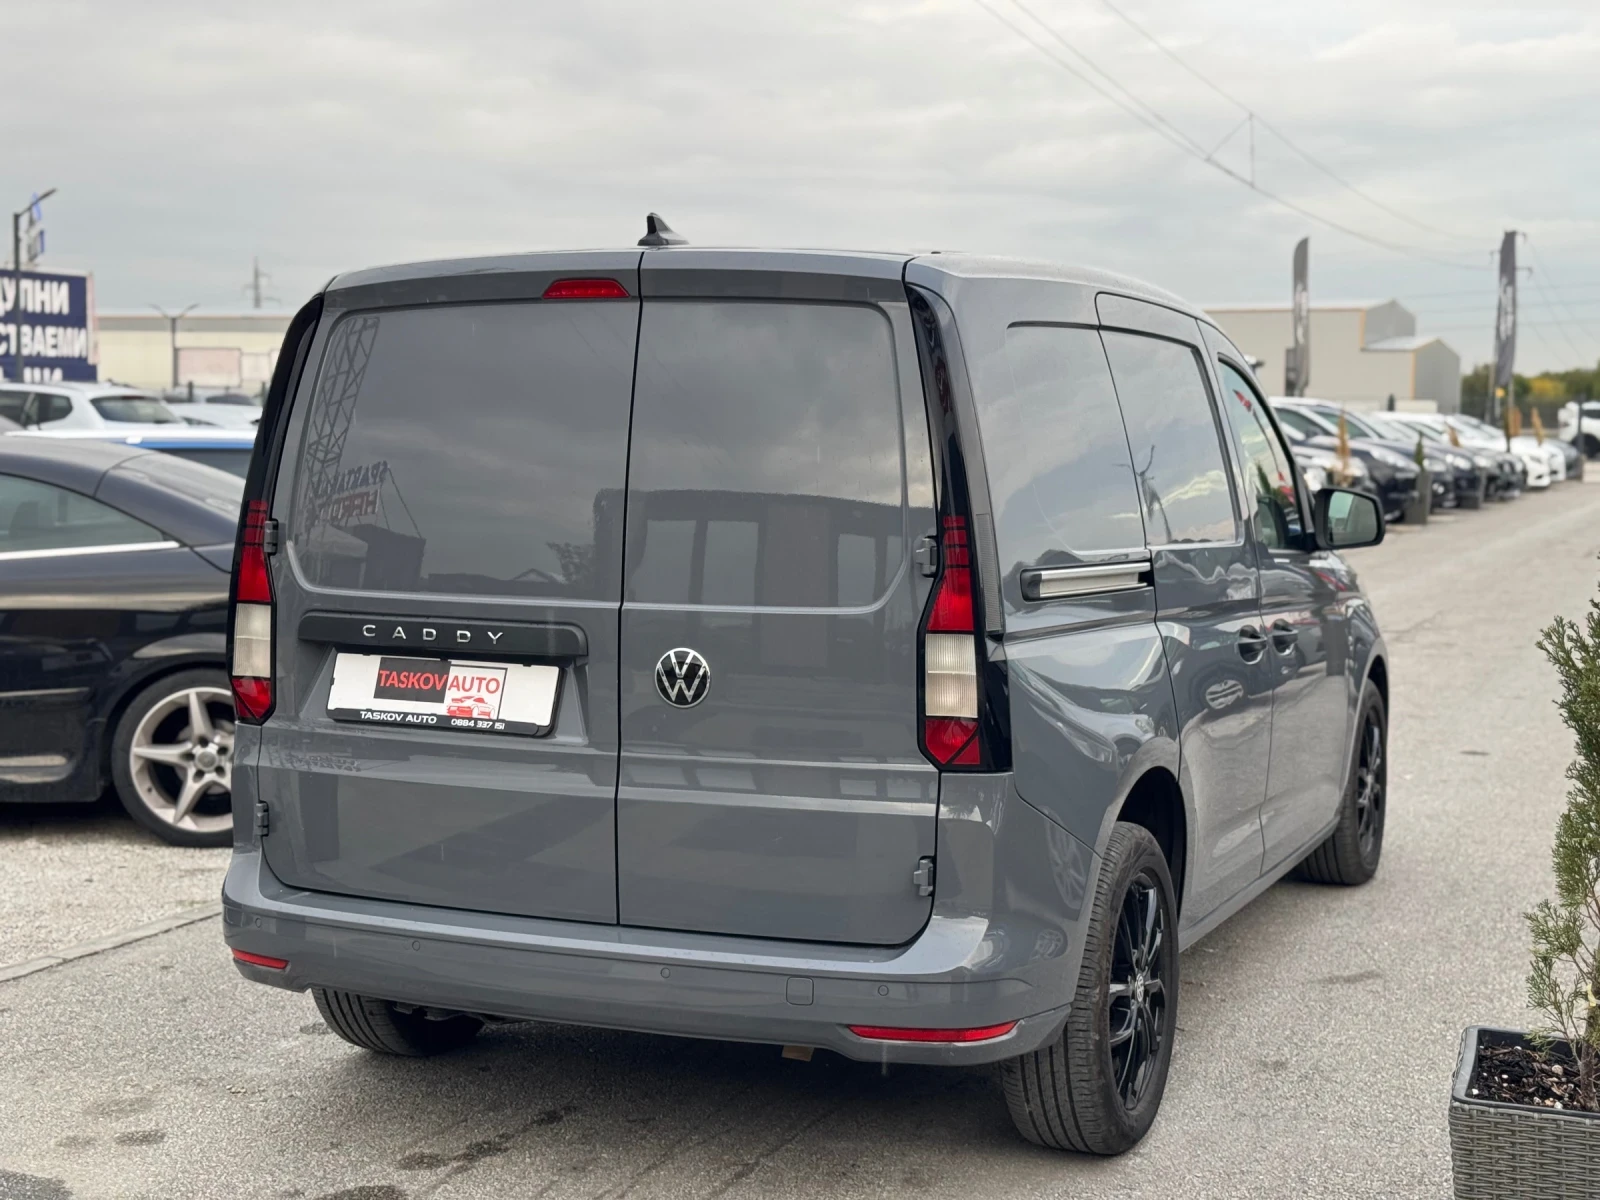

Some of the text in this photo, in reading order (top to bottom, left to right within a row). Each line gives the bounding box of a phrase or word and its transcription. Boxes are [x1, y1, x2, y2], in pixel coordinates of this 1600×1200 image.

[362, 624, 504, 645] CADDY
[379, 670, 501, 694] TASKOV AUTO
[360, 711, 437, 724] TASKOV AUTO
[451, 718, 475, 727] 0884
[476, 720, 493, 729] 337
